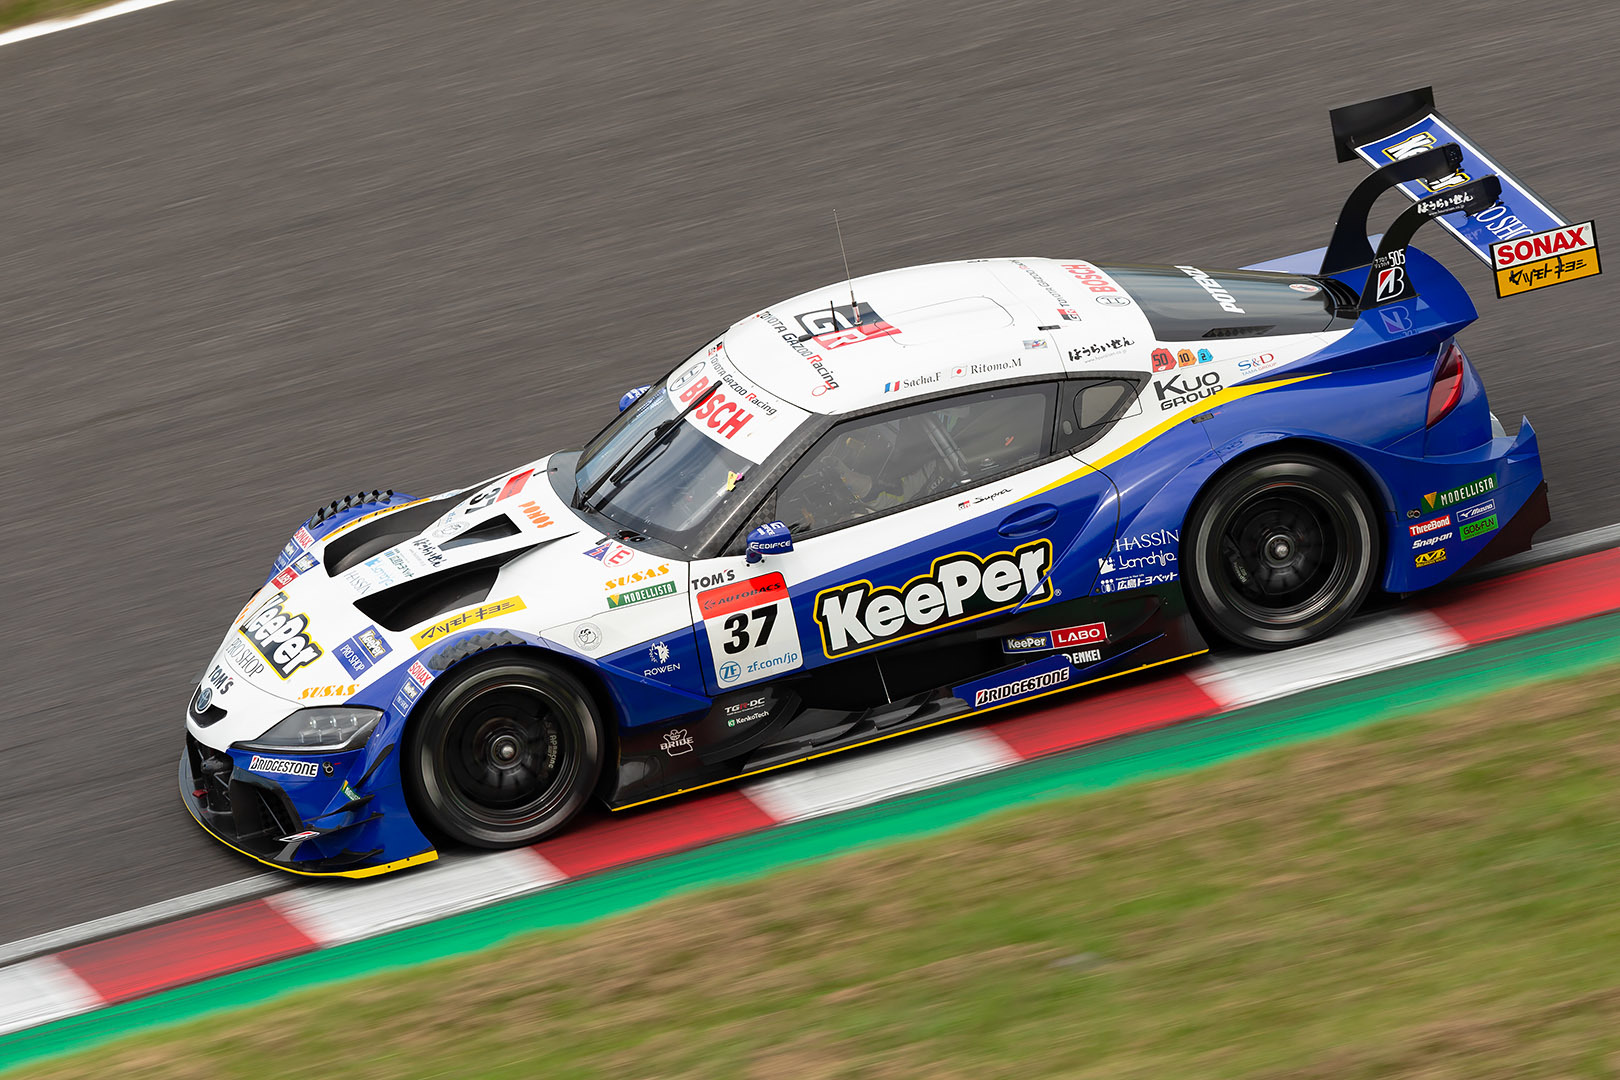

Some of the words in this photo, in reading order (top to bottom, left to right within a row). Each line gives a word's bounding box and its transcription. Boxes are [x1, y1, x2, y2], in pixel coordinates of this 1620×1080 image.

[1497, 226, 1588, 265] SONAX
[1388, 248, 1406, 267] 505
[1061, 264, 1118, 293] BOSCH
[1068, 336, 1135, 362] ほうらいせん
[1179, 353, 1190, 363] 10
[971, 358, 1022, 374] Ritomo.M
[1152, 353, 1169, 367] 50
[1237, 353, 1275, 372] S&D
[807, 354, 840, 391] Racing
[903, 371, 942, 388] Sacha.F
[710, 353, 727, 376] TOYOTA
[723, 373, 748, 396] GAZOO
[745, 392, 777, 416] Racing
[679, 375, 754, 440] BOSCH
[1160, 384, 1224, 411] GROUP
[1440, 477, 1494, 506] MODELLISTA
[518, 500, 555, 529] PONOS
[1409, 516, 1450, 536] ThreeBond
[1463, 517, 1495, 536] GO&FUN
[1115, 529, 1180, 552] HASSIN
[1411, 532, 1453, 549] Snap-on
[604, 563, 670, 591] SUSAS
[623, 584, 673, 604] MODELLISTA
[717, 582, 781, 606] AUTOBACS
[821, 547, 1045, 651] KeePer
[243, 594, 320, 675] KeePer
[723, 603, 778, 655] 37
[1007, 637, 1047, 649] KeePer
[1057, 628, 1100, 643] LABO
[747, 652, 798, 673] zf.com/jp
[1072, 649, 1102, 664] ENKEI
[409, 661, 432, 686] SONAX
[643, 663, 681, 677] ROWEN
[297, 683, 360, 700] SUSAS
[976, 667, 1069, 706] BRIDGESTONE
[736, 710, 770, 725] KenkoTech
[660, 736, 694, 750] BRIDE
[251, 756, 318, 776] BRIDGESTONE
